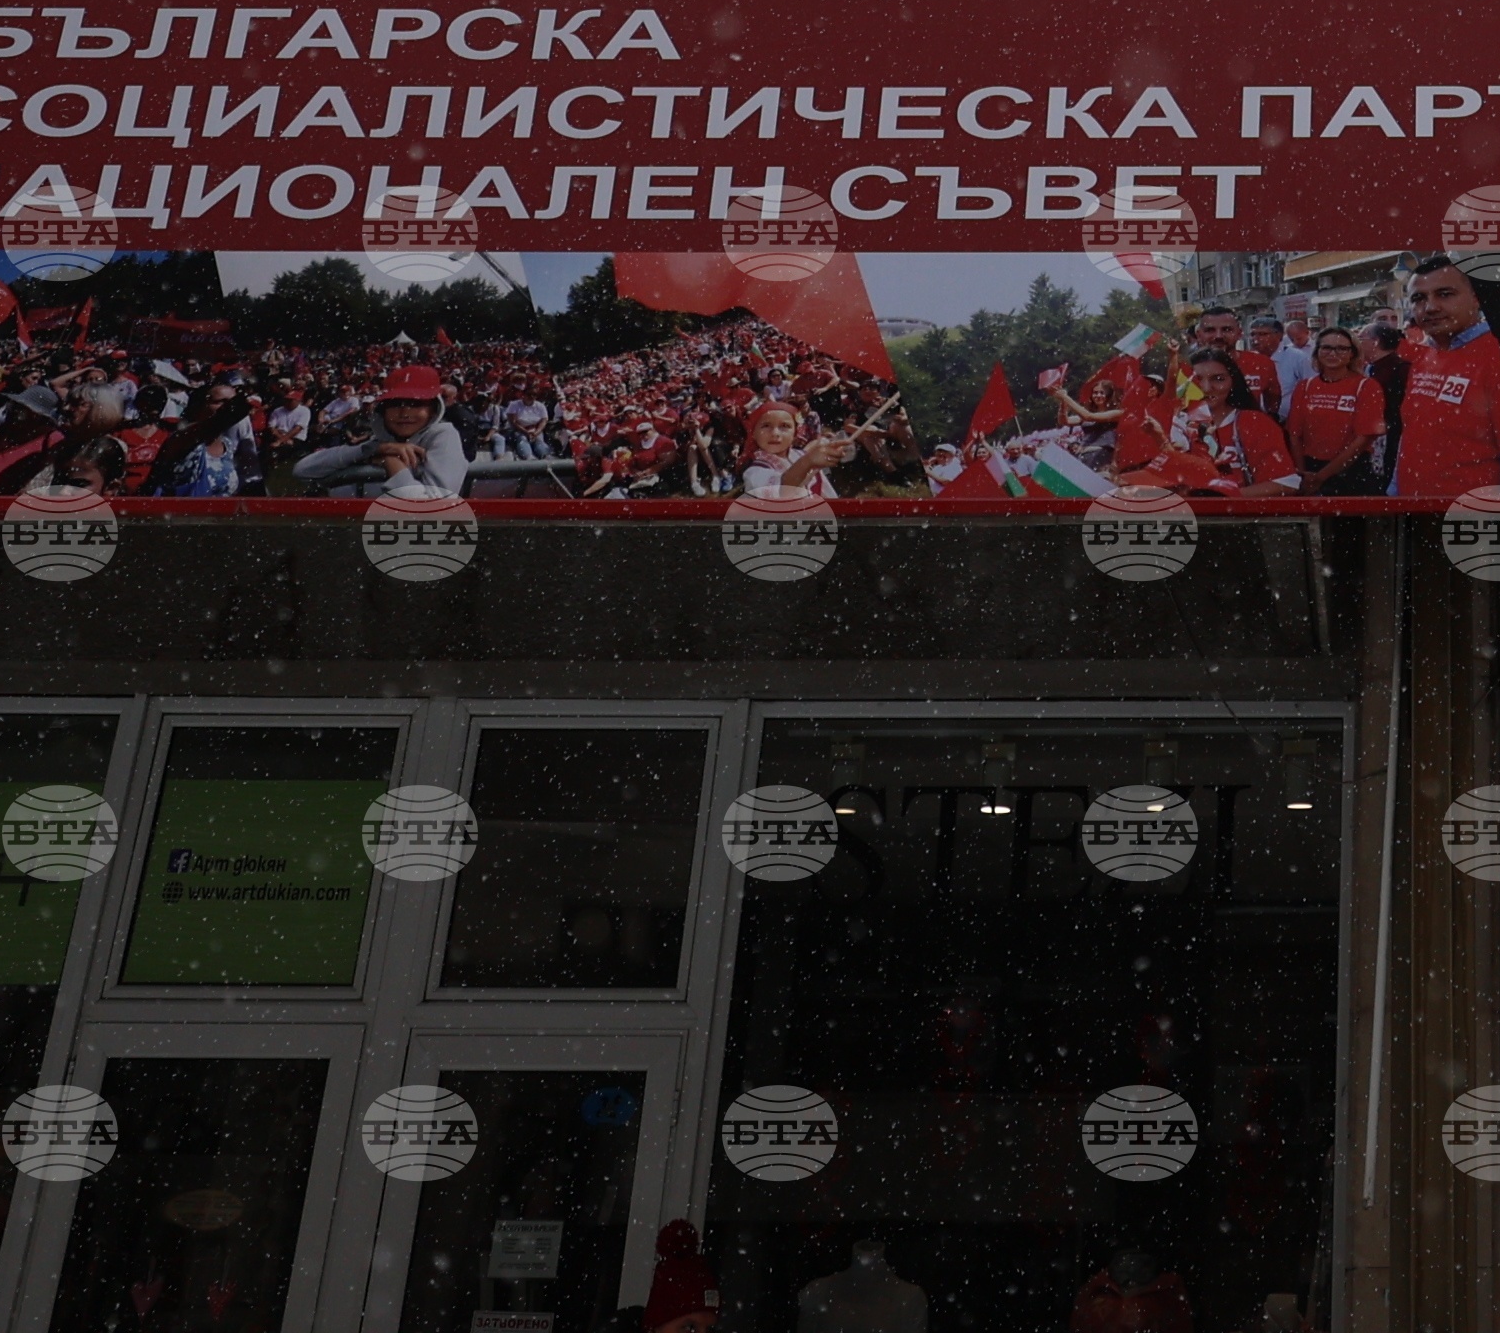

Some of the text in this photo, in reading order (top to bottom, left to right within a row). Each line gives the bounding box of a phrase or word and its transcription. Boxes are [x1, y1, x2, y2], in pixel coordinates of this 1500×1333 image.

[830, 163, 1263, 221] СЪВЕТ
[1442, 380, 1466, 398] 28
[192, 854, 229, 876] Арт
[188, 882, 351, 902] www.artdukian.com
[475, 1317, 549, 1330] ЗАТВОРЕНО
